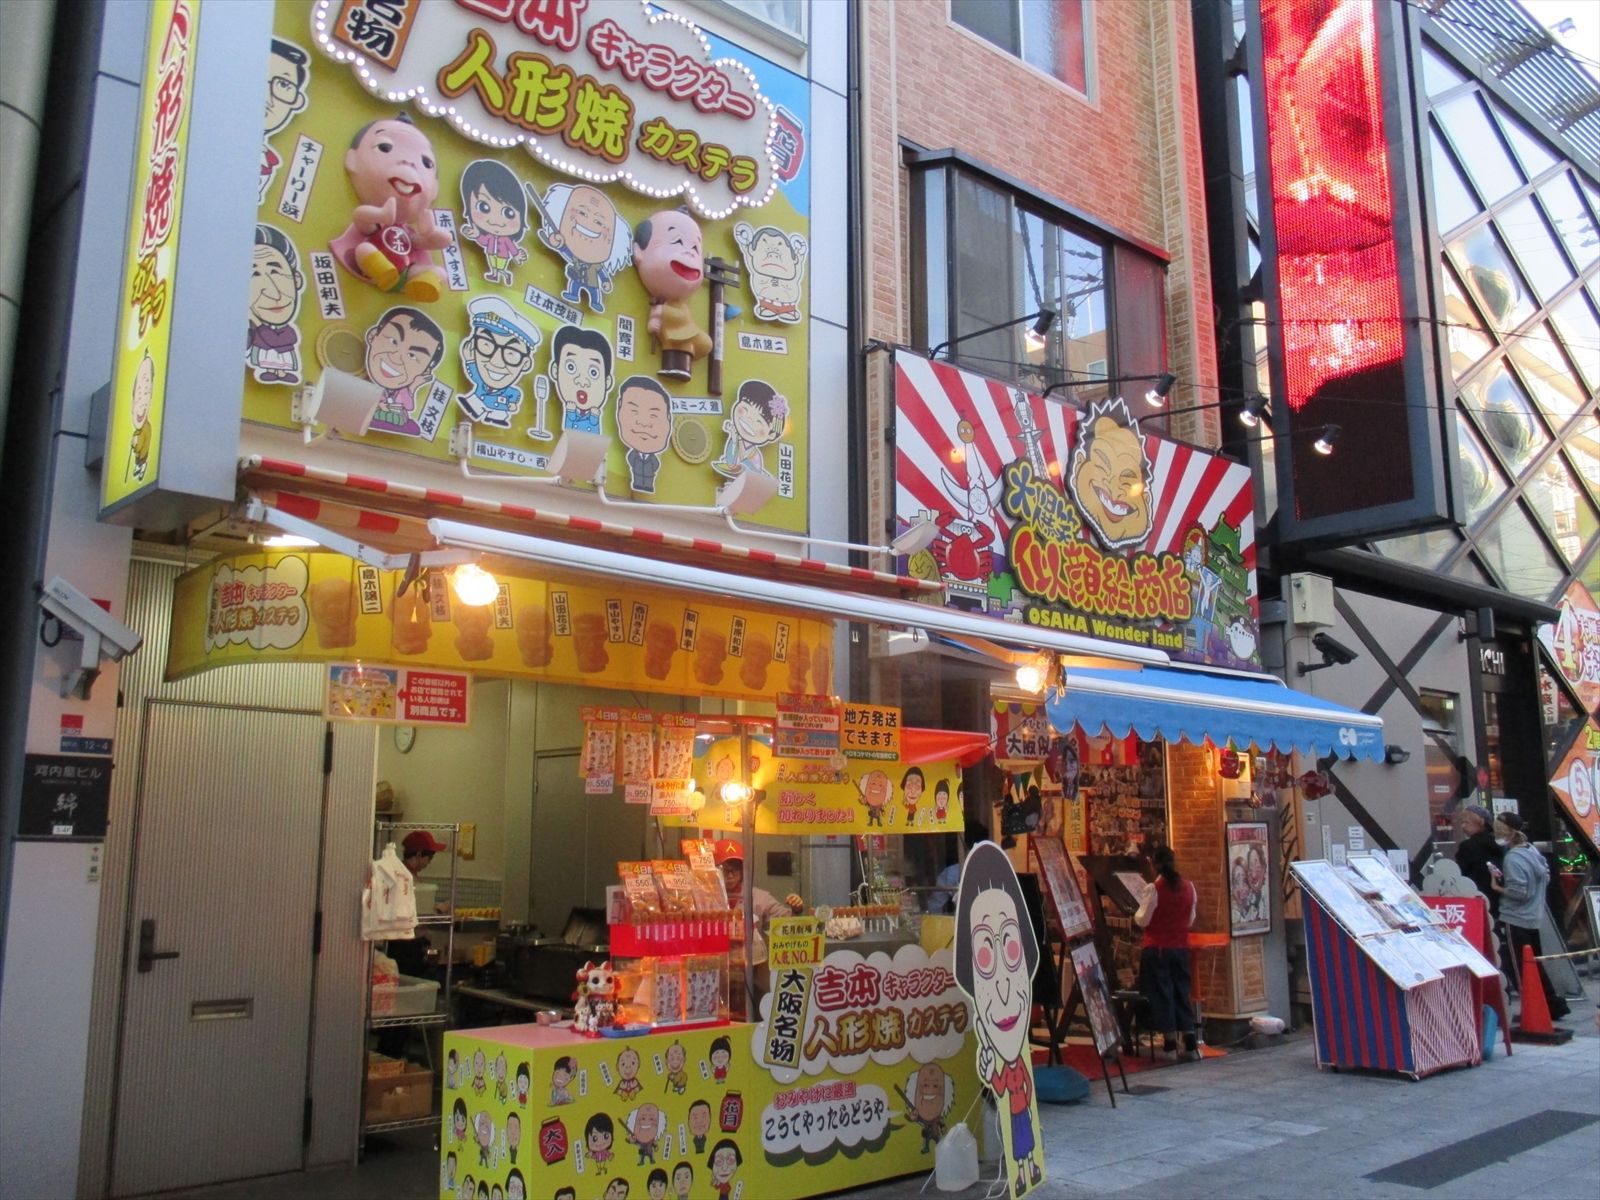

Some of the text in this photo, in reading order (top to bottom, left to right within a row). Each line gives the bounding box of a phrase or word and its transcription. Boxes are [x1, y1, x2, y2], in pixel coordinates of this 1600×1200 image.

[588, 19, 755, 120] キャラクター
[437, 27, 759, 194] 人形焼 カステラ
[282, 141, 316, 219] チャーリー浜
[315, 256, 341, 316] 坂田利夫
[530, 288, 578, 325] 辻本茂雄
[420, 386, 447, 435] 桂文枝
[476, 444, 548, 468] 横山やすし・西
[780, 447, 792, 494] 山田花子
[1013, 527, 1191, 619] 似顔絵商店
[555, 594, 568, 634] 山田花子
[1029, 607, 1183, 649] OSAKA Wonder land
[844, 708, 897, 728] 地方発送
[844, 729, 897, 747] できます。
[813, 962, 956, 1011] 吉本 キャラクター
[770, 968, 806, 1063] 大阪名物
[804, 1001, 969, 1061] 人形焼 カステラ
[723, 1100, 739, 1126] 花月
[765, 1097, 885, 1141] こうてやったらどうや
